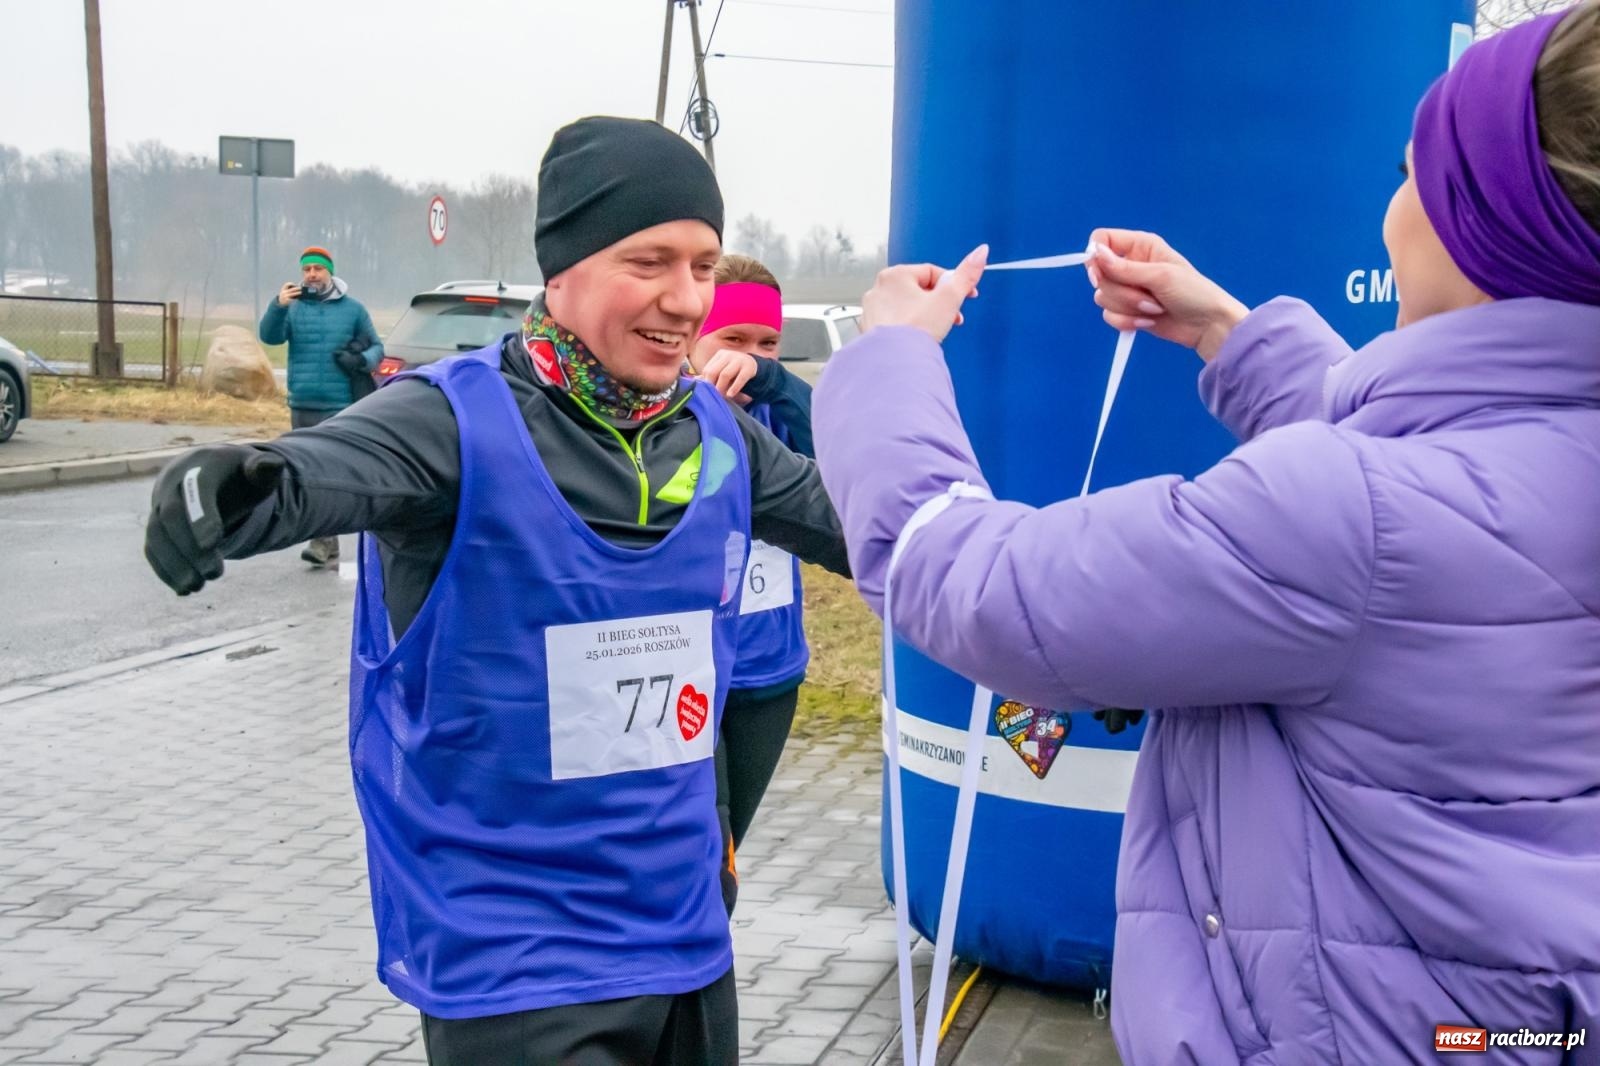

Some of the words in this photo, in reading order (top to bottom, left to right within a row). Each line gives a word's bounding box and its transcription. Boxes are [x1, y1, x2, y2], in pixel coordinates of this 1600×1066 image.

[432, 208, 446, 231] 70
[1345, 269, 1400, 304] GM
[597, 632, 606, 643] II
[609, 629, 636, 642] BIEG
[638, 624, 681, 639] SOŁTYSA
[585, 643, 642, 661] 25.01.2026
[644, 636, 691, 653] ROSZKÓW
[616, 673, 674, 734] 77
[1036, 717, 1057, 736] 34
[899, 731, 989, 772] GMINAKRZYZANOE
